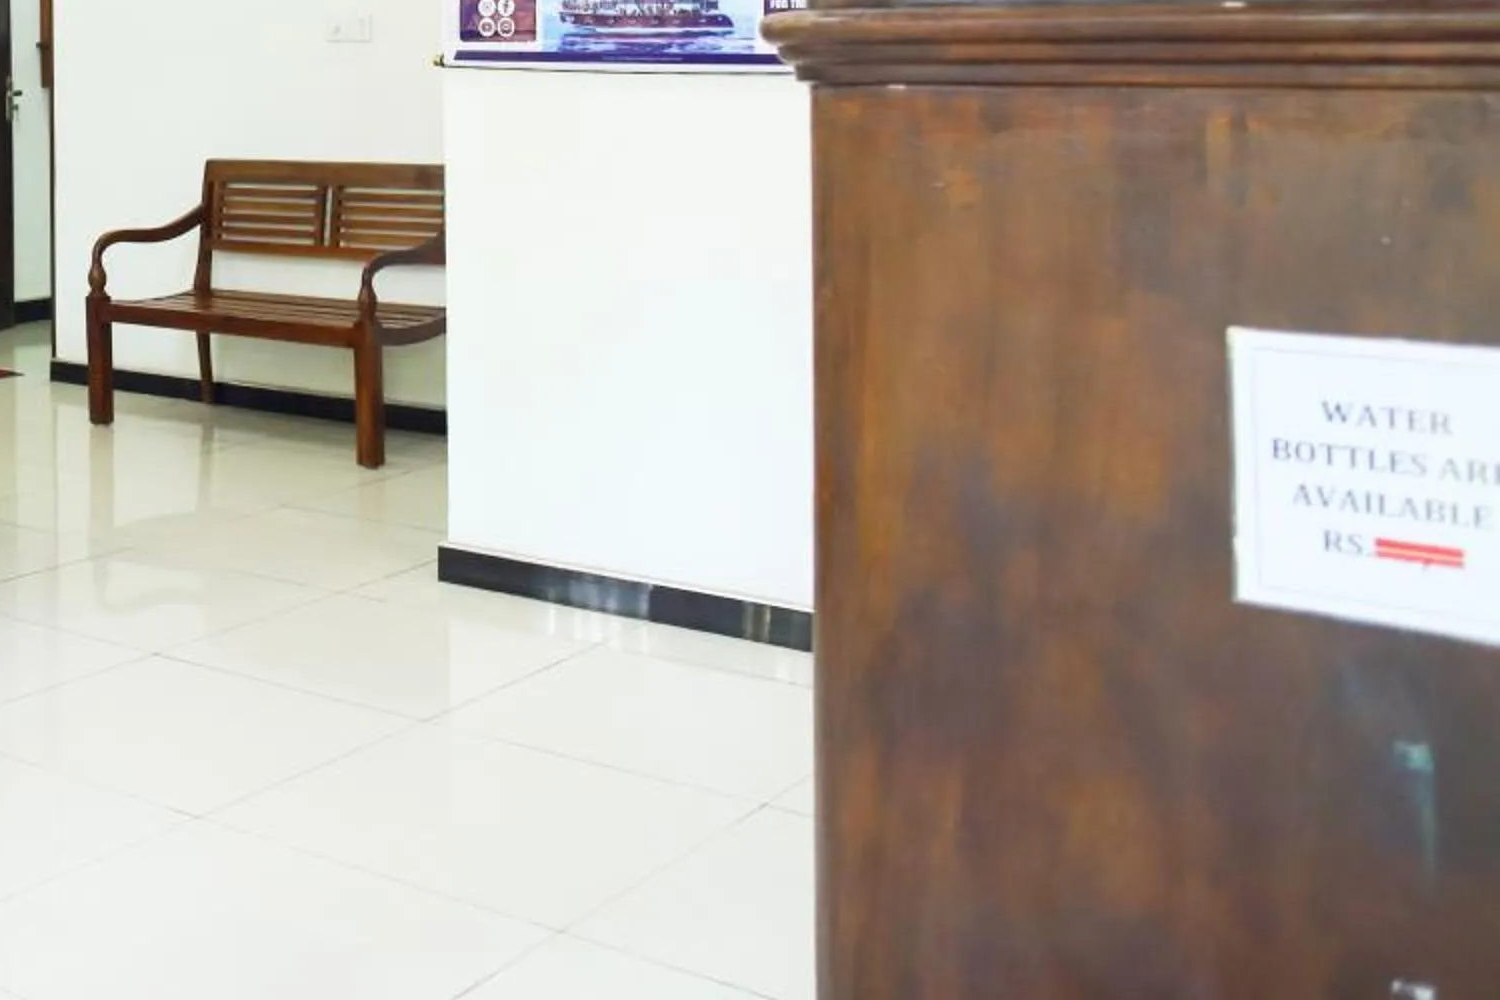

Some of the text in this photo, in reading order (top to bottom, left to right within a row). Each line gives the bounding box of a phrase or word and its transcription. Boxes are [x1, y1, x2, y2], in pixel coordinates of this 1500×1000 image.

[1320, 399, 1454, 435] WATER
[1272, 437, 1428, 475] BOTTLES
[1292, 483, 1494, 530] AVAILABLE
